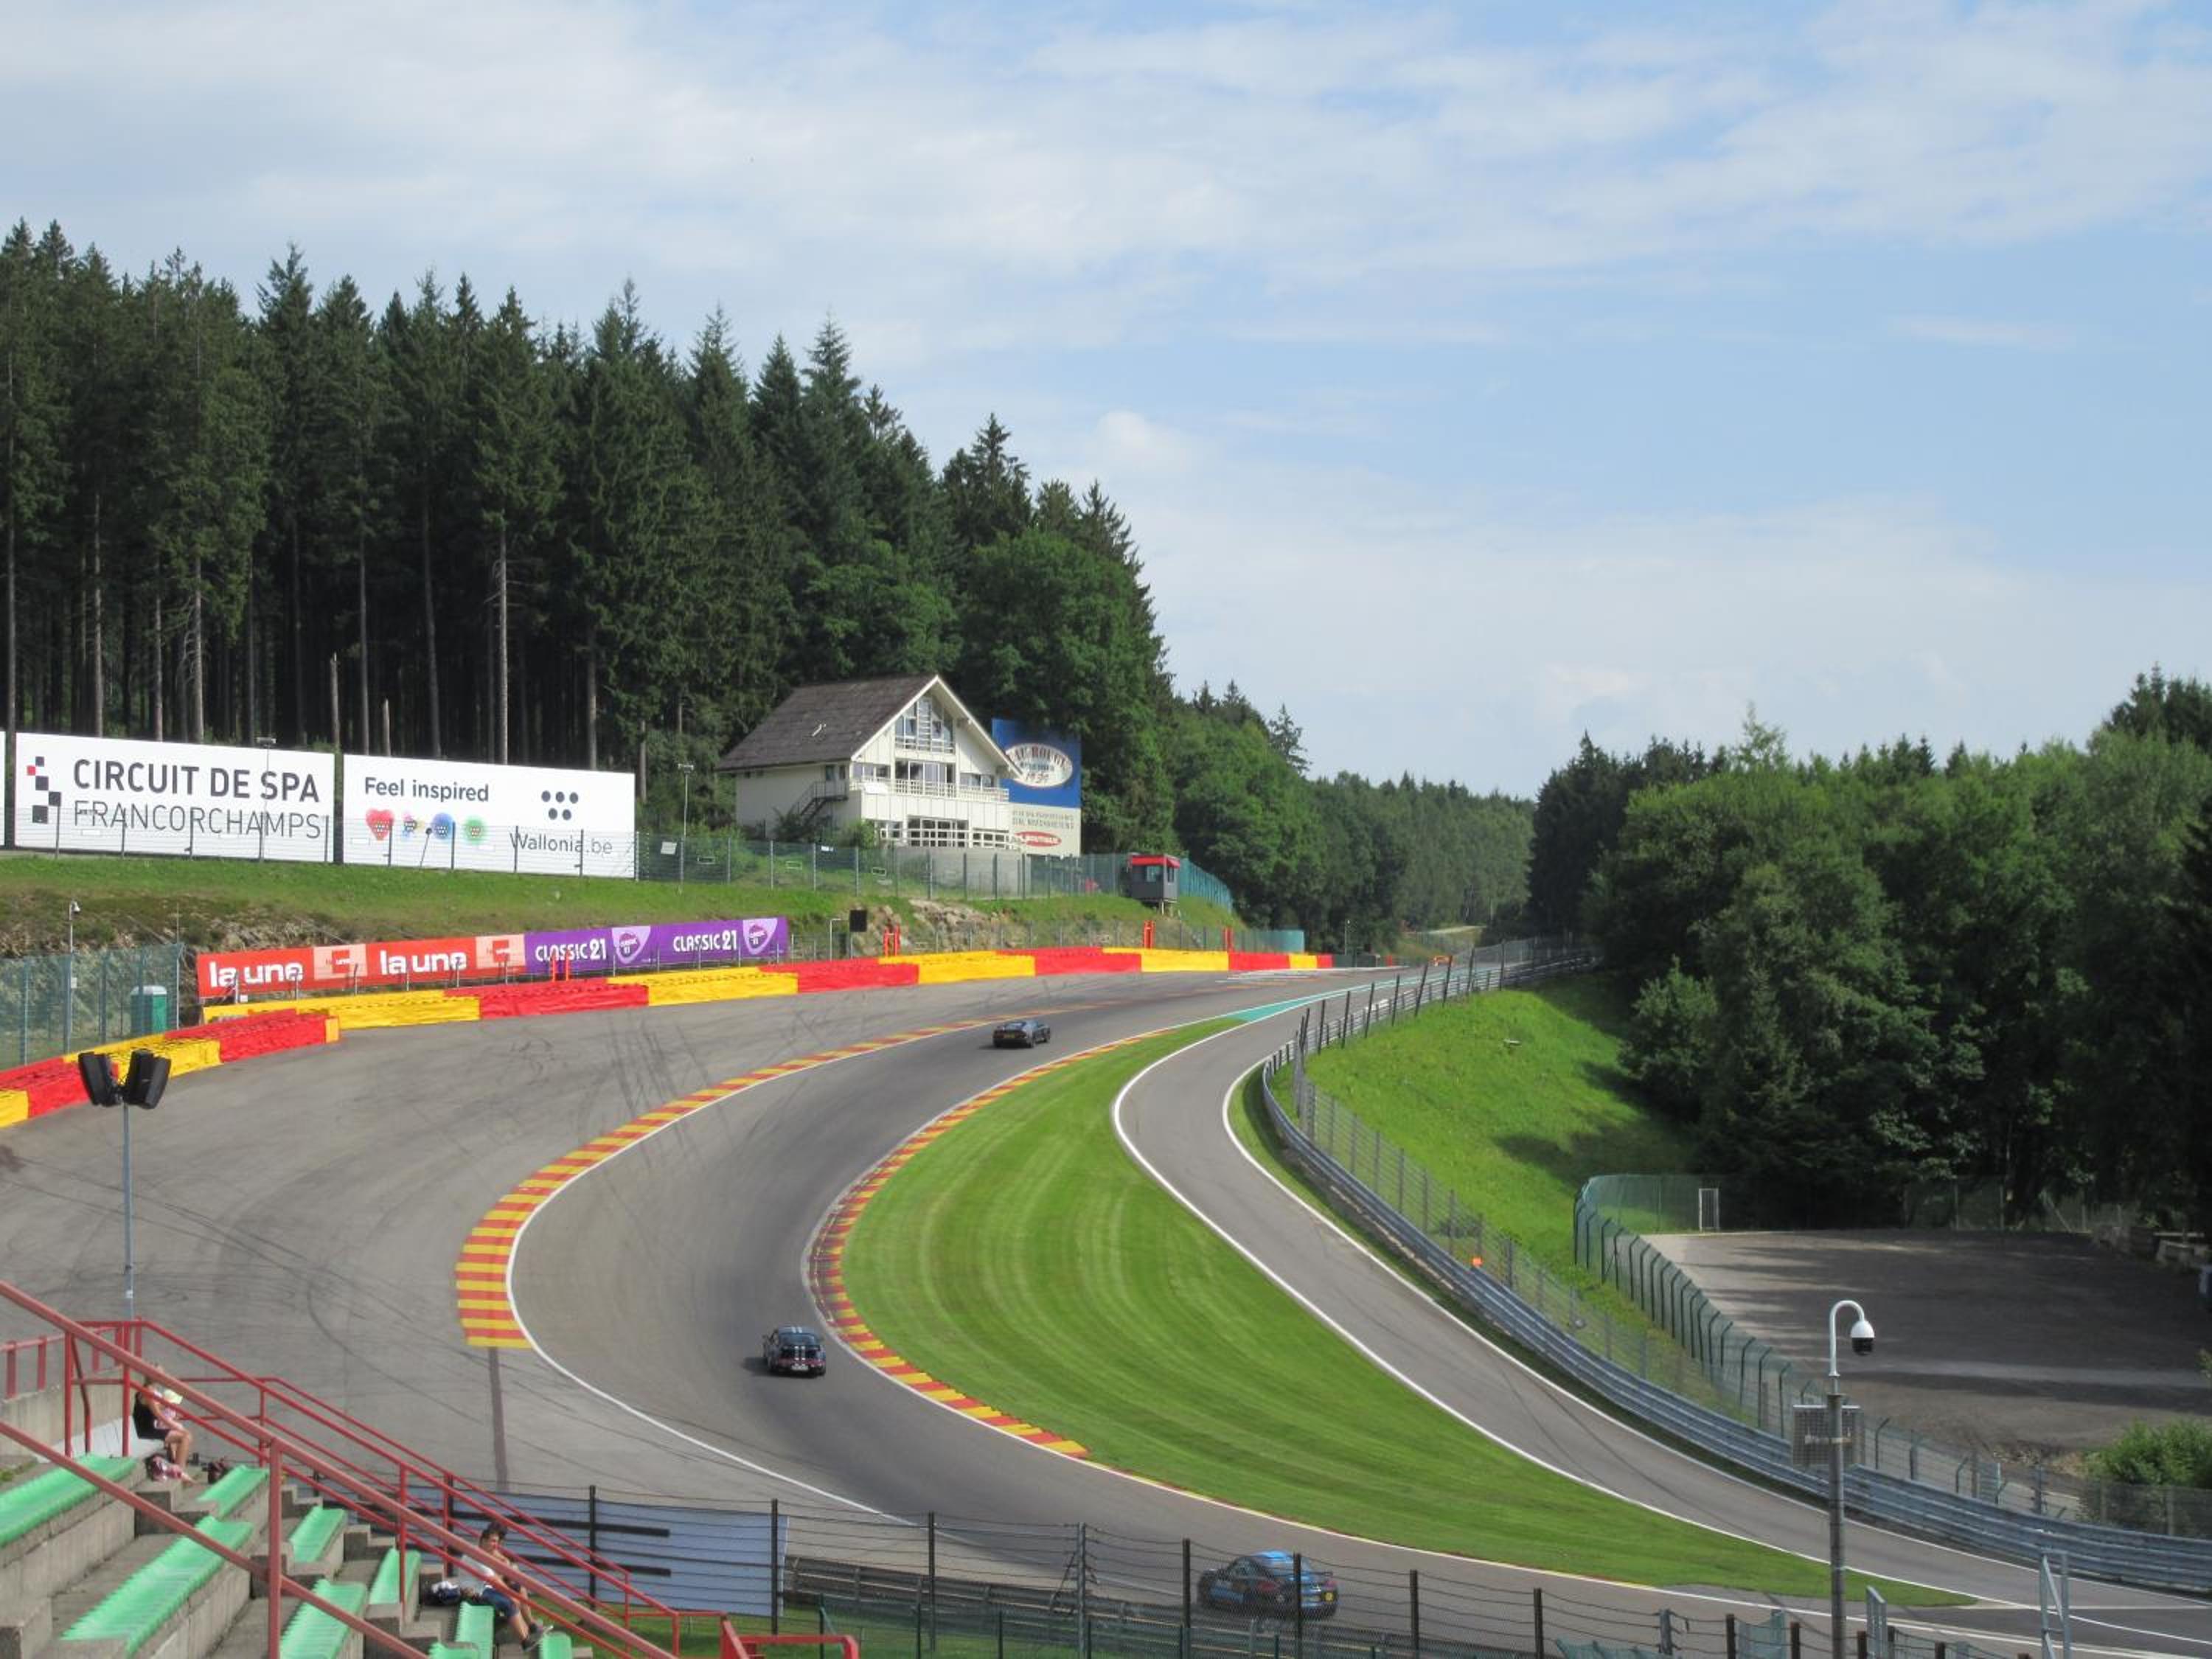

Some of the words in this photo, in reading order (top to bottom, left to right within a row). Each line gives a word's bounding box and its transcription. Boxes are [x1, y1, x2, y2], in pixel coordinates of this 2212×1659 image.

[74, 758, 199, 795] CIRCUIT
[211, 768, 250, 799] DE
[261, 771, 320, 803] SPA
[365, 776, 404, 797] Feel
[413, 779, 489, 802] inspired
[74, 800, 321, 839] FRANCORCHAMPS
[509, 832, 613, 855] Wallonia.be
[535, 942, 588, 961] CLASSIC
[589, 937, 606, 961] 21
[673, 933, 720, 952] CLASSIC
[722, 929, 737, 950] 21
[209, 961, 237, 987] la
[244, 961, 304, 985] une
[380, 950, 407, 975] la
[411, 950, 467, 971] une
